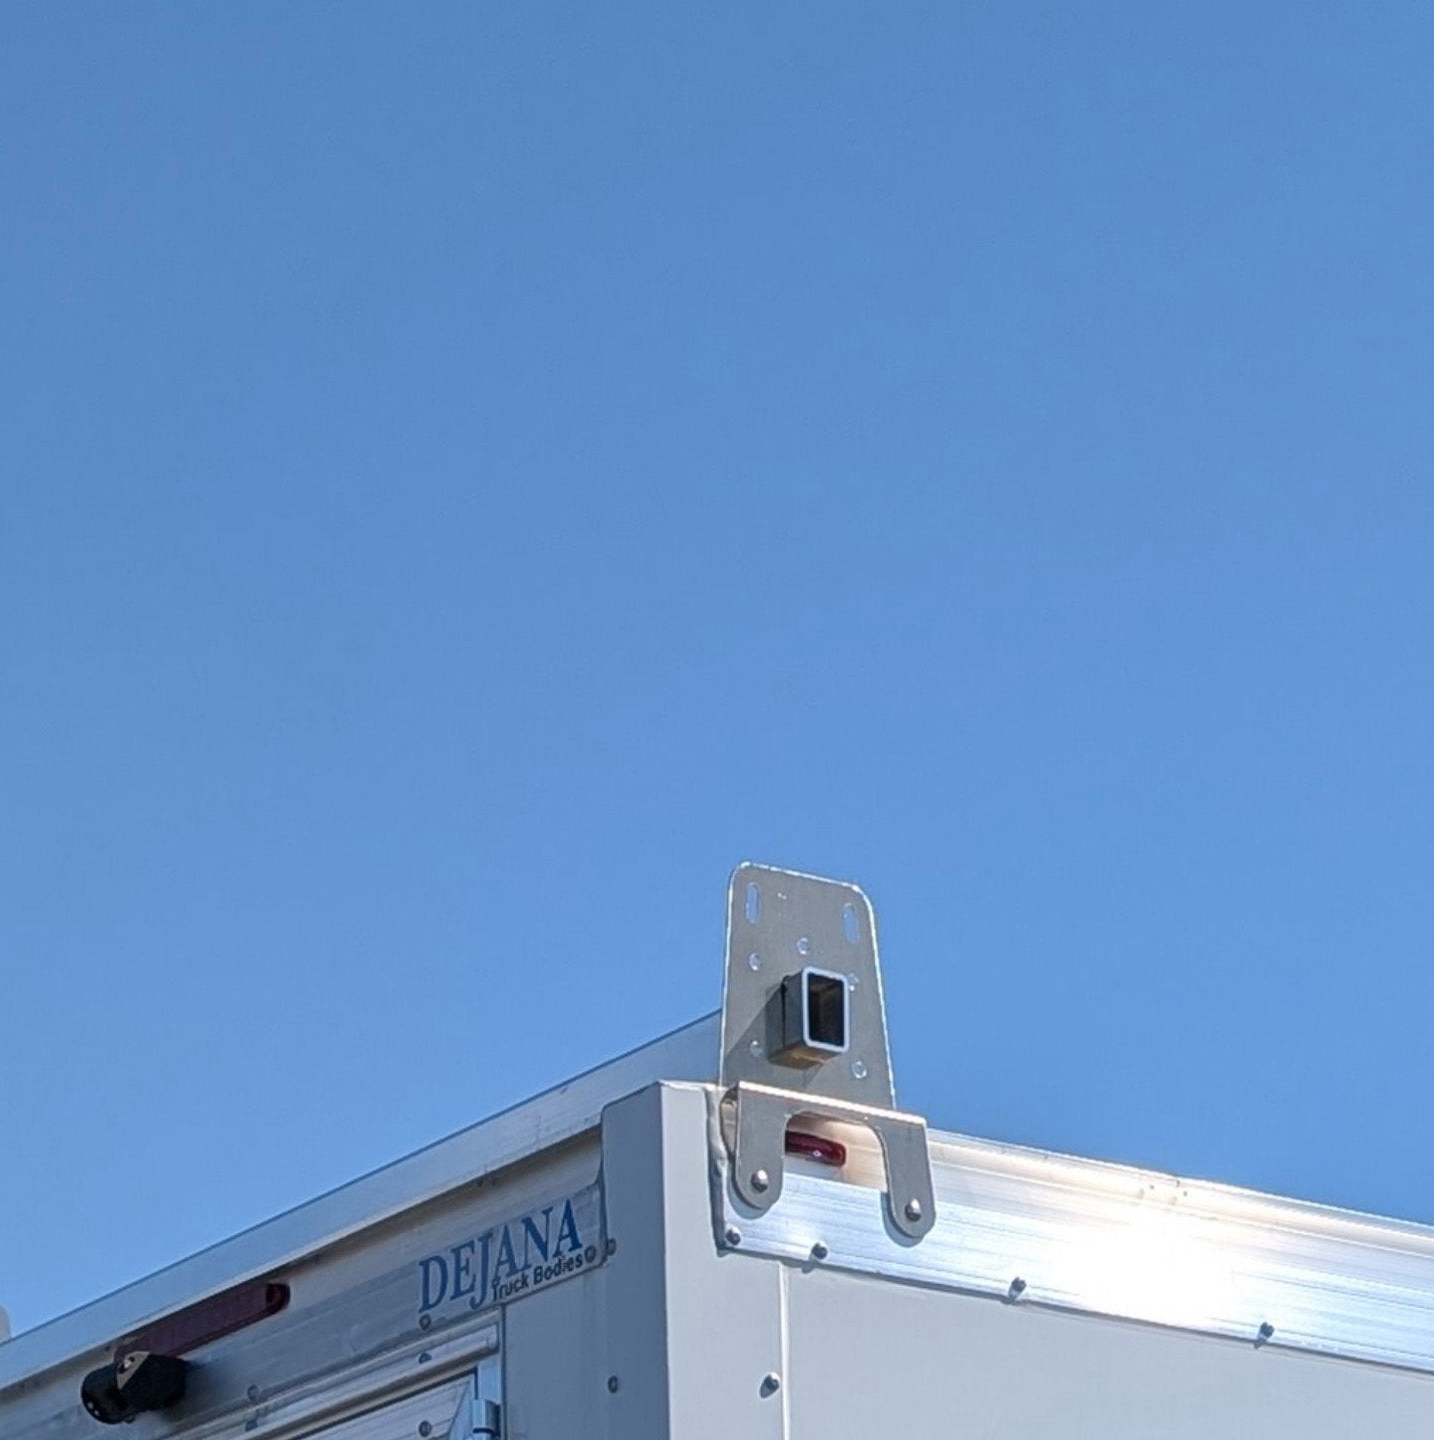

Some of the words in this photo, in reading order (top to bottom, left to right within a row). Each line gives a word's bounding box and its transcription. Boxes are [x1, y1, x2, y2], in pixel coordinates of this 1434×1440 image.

[418, 1199, 583, 1313] DEJANA
[492, 1274, 530, 1302] Truck
[533, 1251, 584, 1286] Bodies
